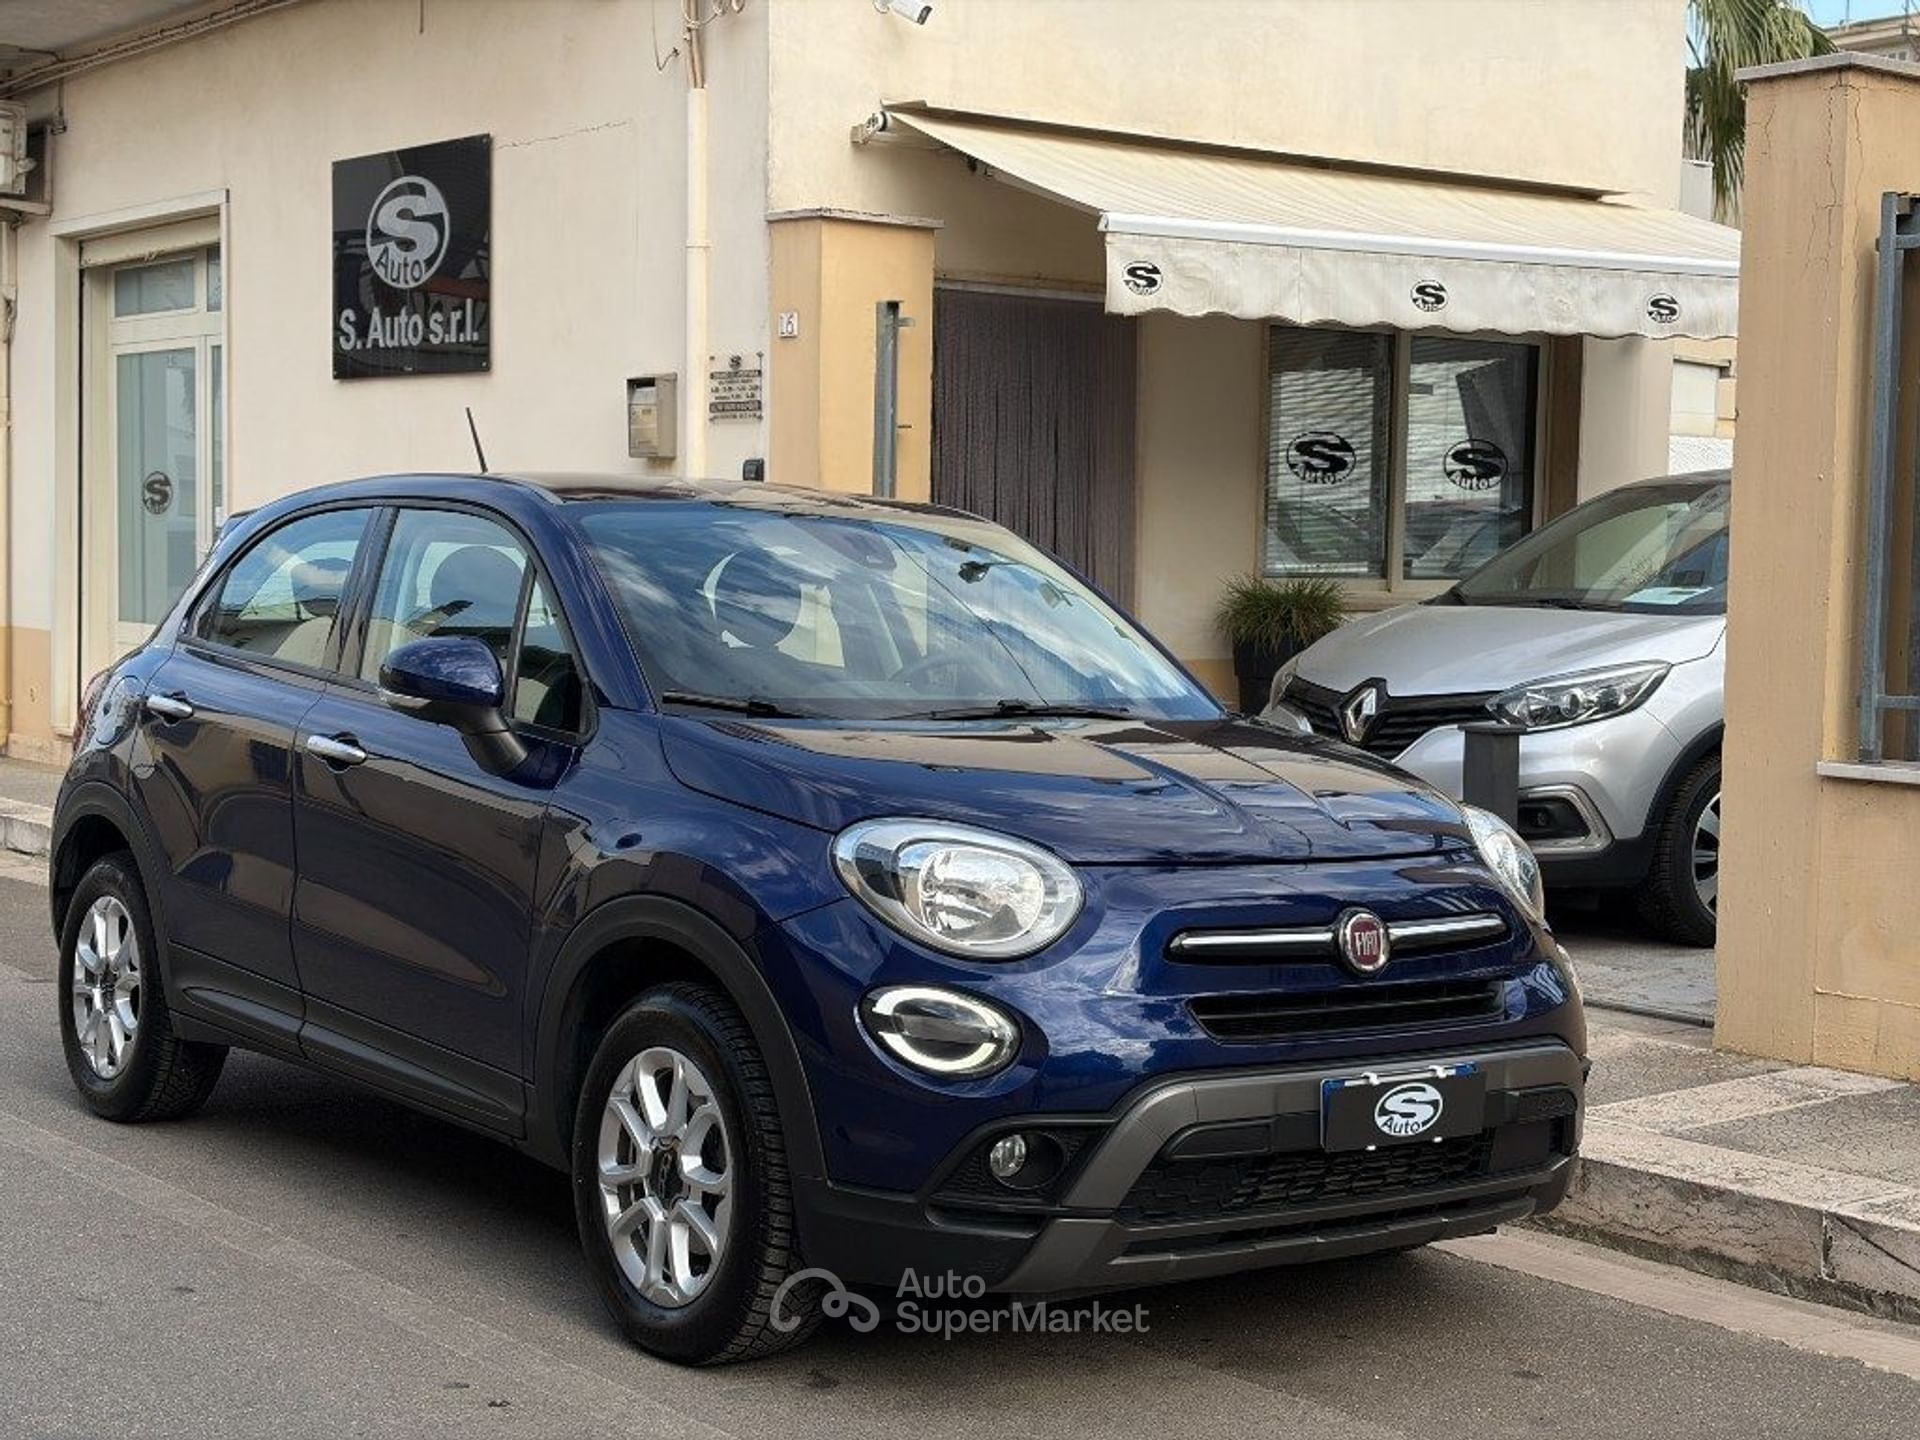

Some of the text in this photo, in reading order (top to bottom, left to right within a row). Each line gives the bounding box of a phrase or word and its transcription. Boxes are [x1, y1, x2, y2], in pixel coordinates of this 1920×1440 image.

[370, 180, 446, 262] S
[375, 246, 425, 286] Auto
[1124, 263, 1161, 288] S
[1412, 283, 1446, 305] S
[1648, 296, 1679, 316] S
[339, 298, 479, 350] S. Auto s.r.l.
[1450, 470, 1489, 491] Auto
[1354, 930, 1379, 956] FIAT
[1378, 1085, 1441, 1128] S
[1381, 1115, 1421, 1134] Auto
